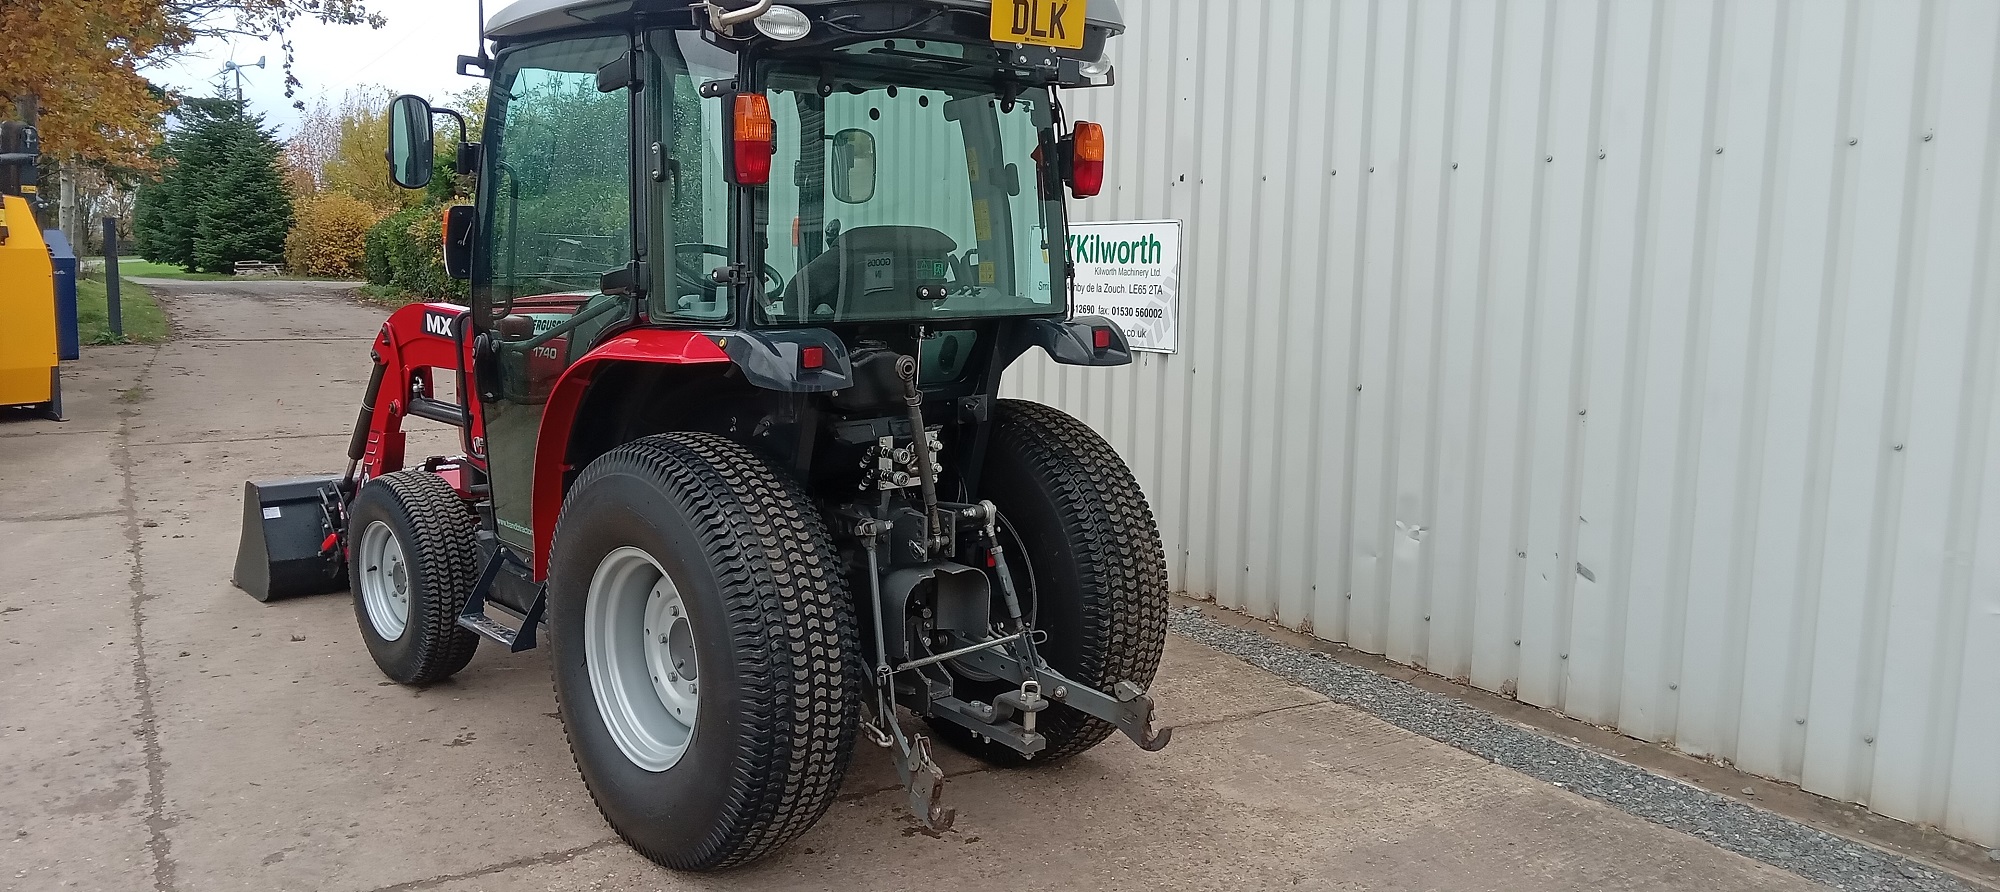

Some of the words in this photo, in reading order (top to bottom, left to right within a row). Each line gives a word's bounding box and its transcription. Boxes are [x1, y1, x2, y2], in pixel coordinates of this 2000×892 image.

[1011, 0, 1068, 39] DLK
[1095, 267, 1117, 276] Kilworth
[1118, 267, 1149, 279] Machinery
[1086, 283, 1095, 293] de
[1096, 283, 1102, 293] la
[1128, 284, 1147, 295] LE65
[1148, 285, 1163, 295] 2TA
[1111, 306, 1134, 317] 01530
[1135, 307, 1163, 319] 560002
[426, 314, 453, 337] MX
[533, 346, 557, 360] 1740
